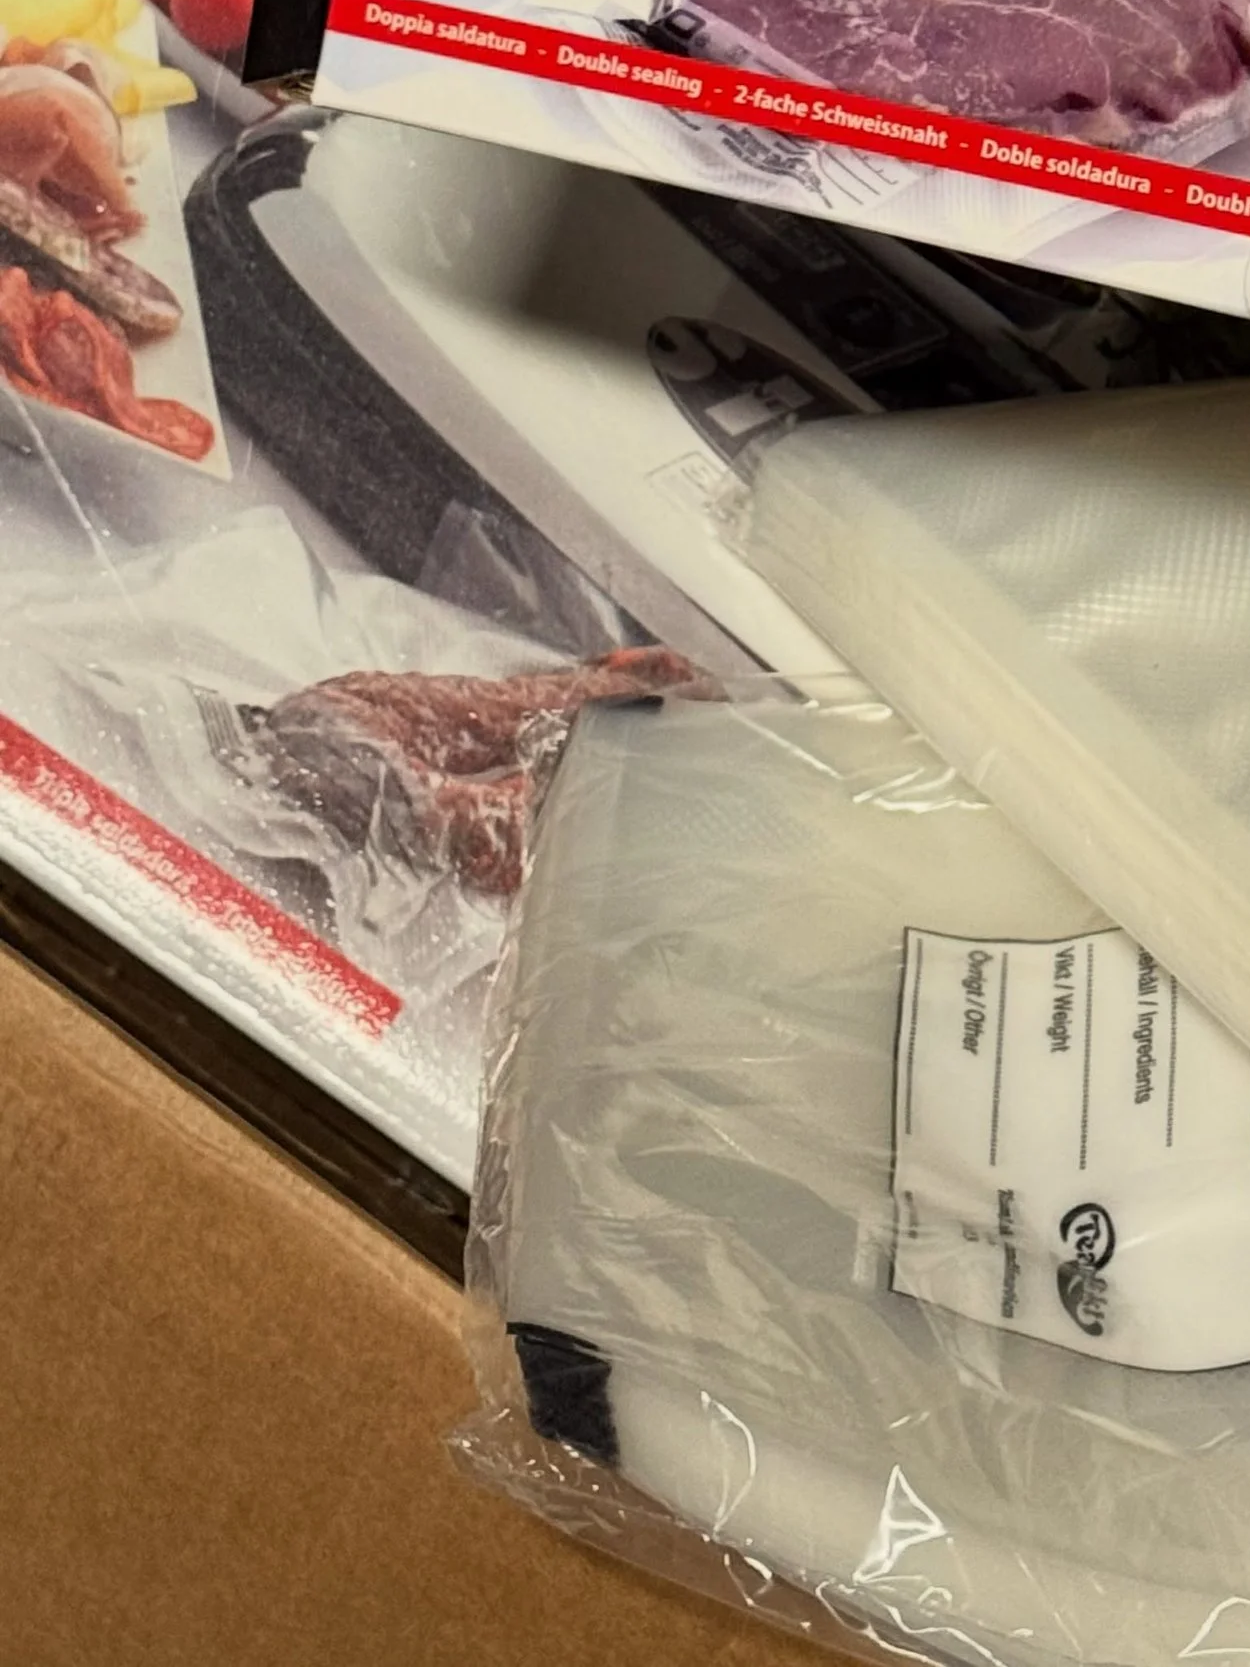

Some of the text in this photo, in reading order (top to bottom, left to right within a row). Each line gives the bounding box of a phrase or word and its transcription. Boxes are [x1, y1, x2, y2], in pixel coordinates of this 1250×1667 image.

[365, 2, 435, 35] Doppia
[436, 20, 527, 56] saldatura
[556, 45, 629, 78] Double
[631, 62, 703, 98] sealing
[733, 84, 809, 117] 2-fache
[811, 99, 949, 150] Schweissnaht
[980, 137, 1043, 172] Doble
[1045, 156, 1152, 195] soldadura
[961, 950, 994, 997] Övrigt
[1054, 945, 1076, 982] Vikt
[962, 1009, 986, 1056] Other
[1046, 992, 1075, 1053] Weight
[1133, 1010, 1159, 1106] Ingredients
